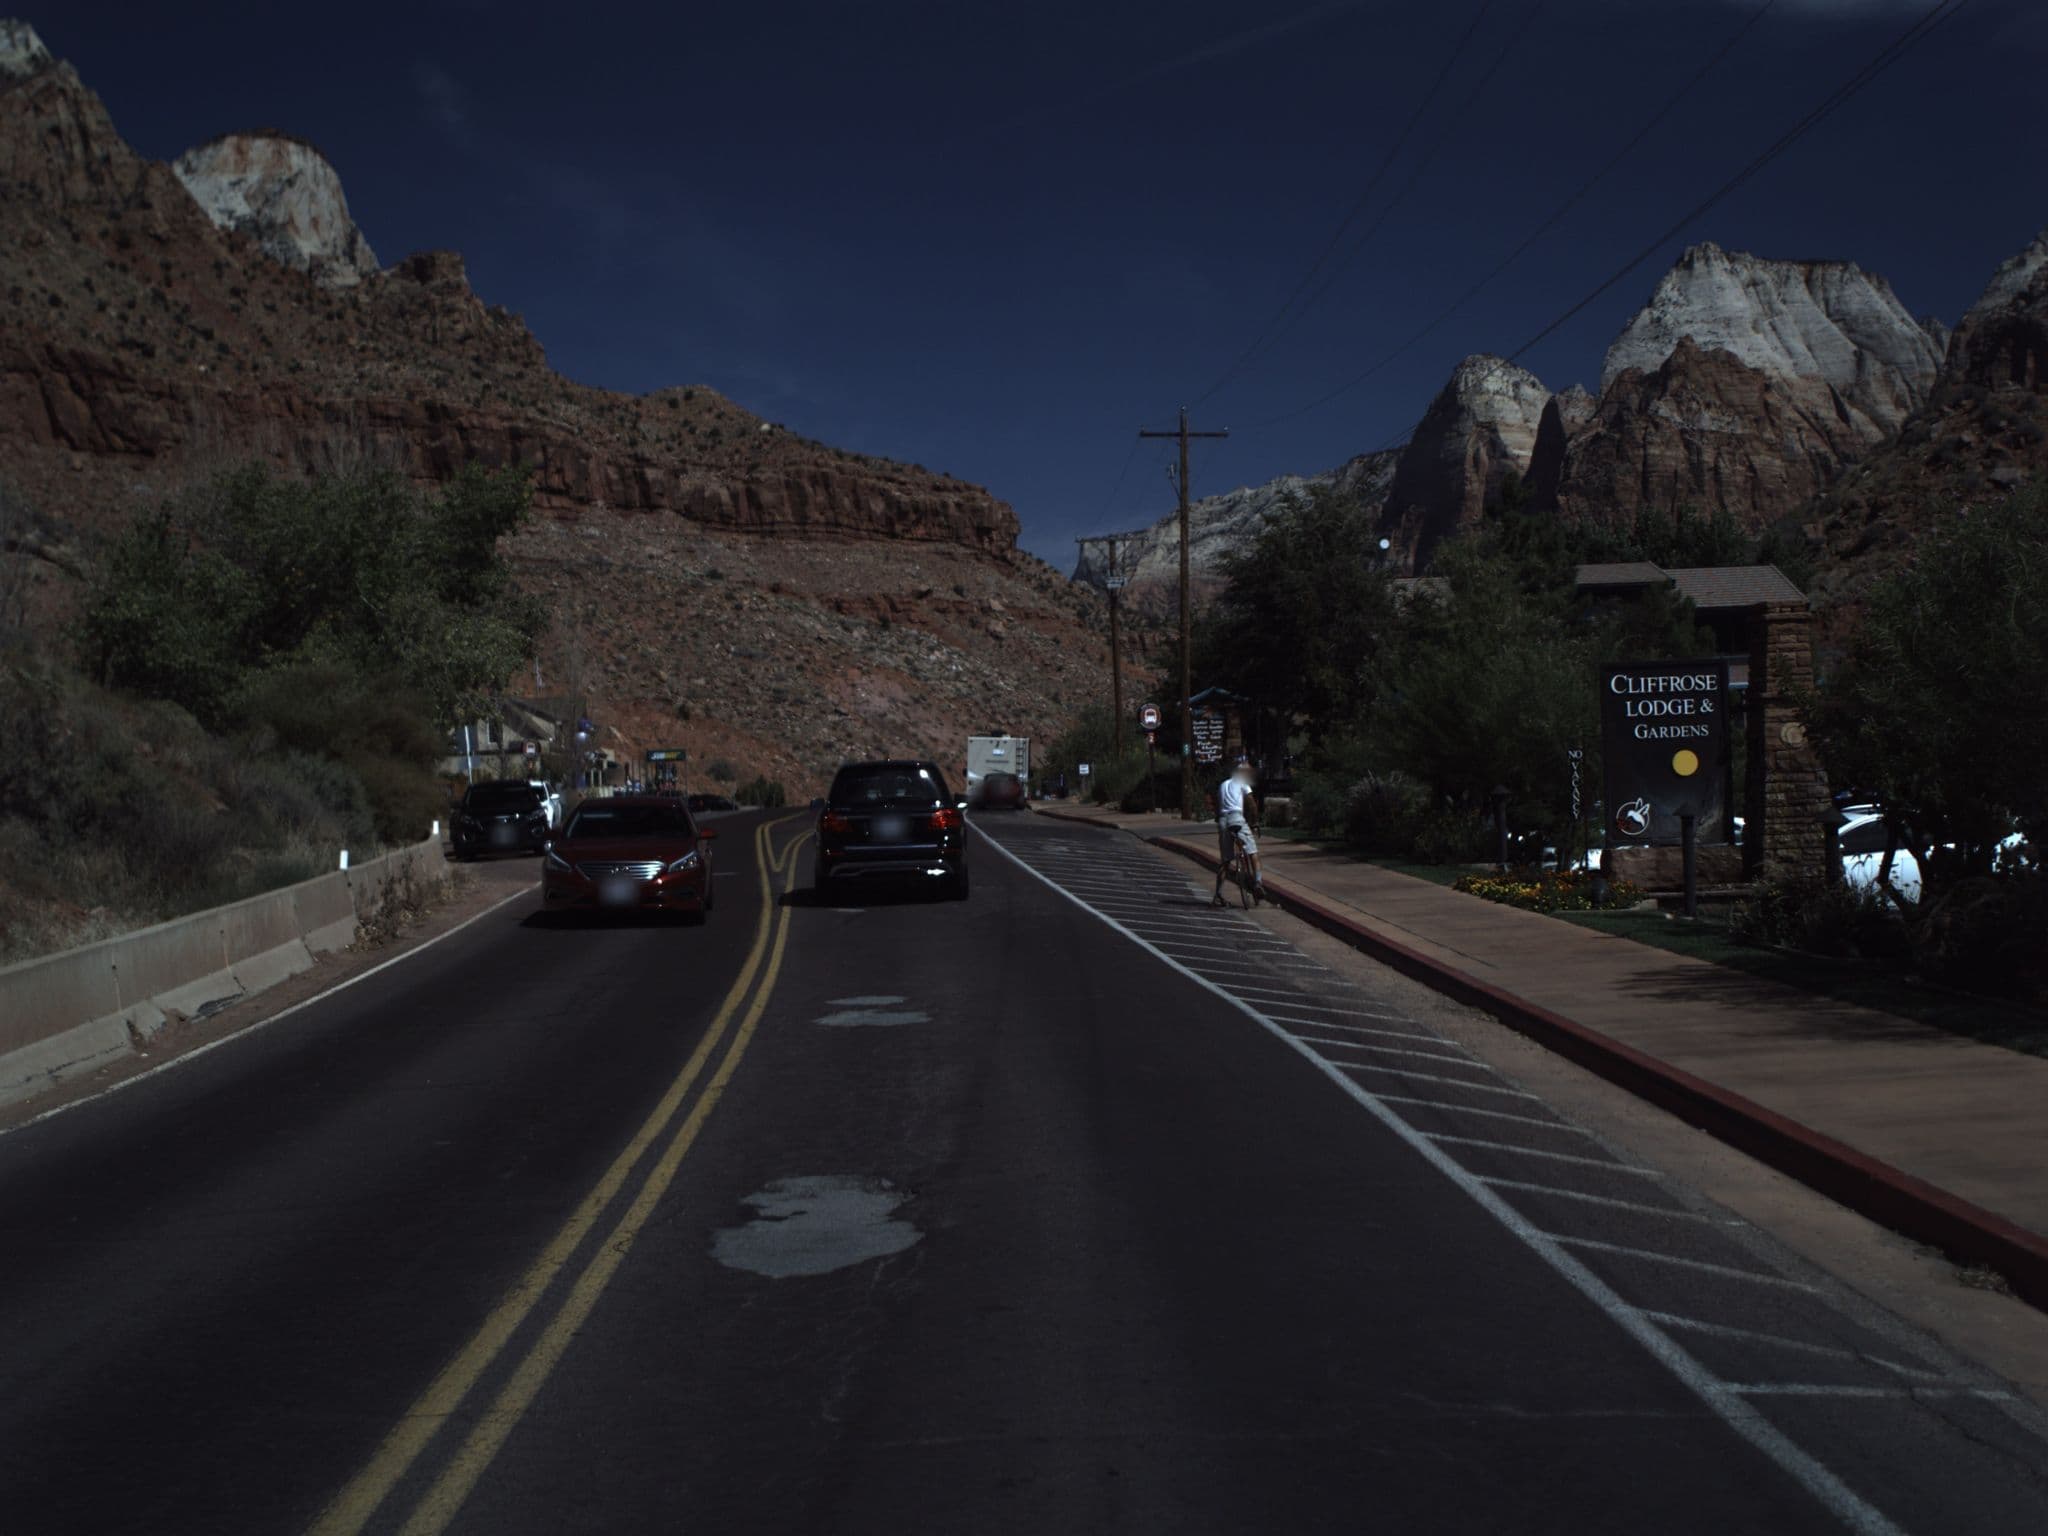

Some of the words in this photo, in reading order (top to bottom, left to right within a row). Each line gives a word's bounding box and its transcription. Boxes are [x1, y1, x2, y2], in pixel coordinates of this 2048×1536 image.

[1610, 674, 1718, 694] CLIFFROSE
[1625, 699, 1696, 717] LODGE
[1700, 698, 1715, 713] &
[1634, 724, 1709, 740] GARDENS
[1568, 750, 1583, 759] NO
